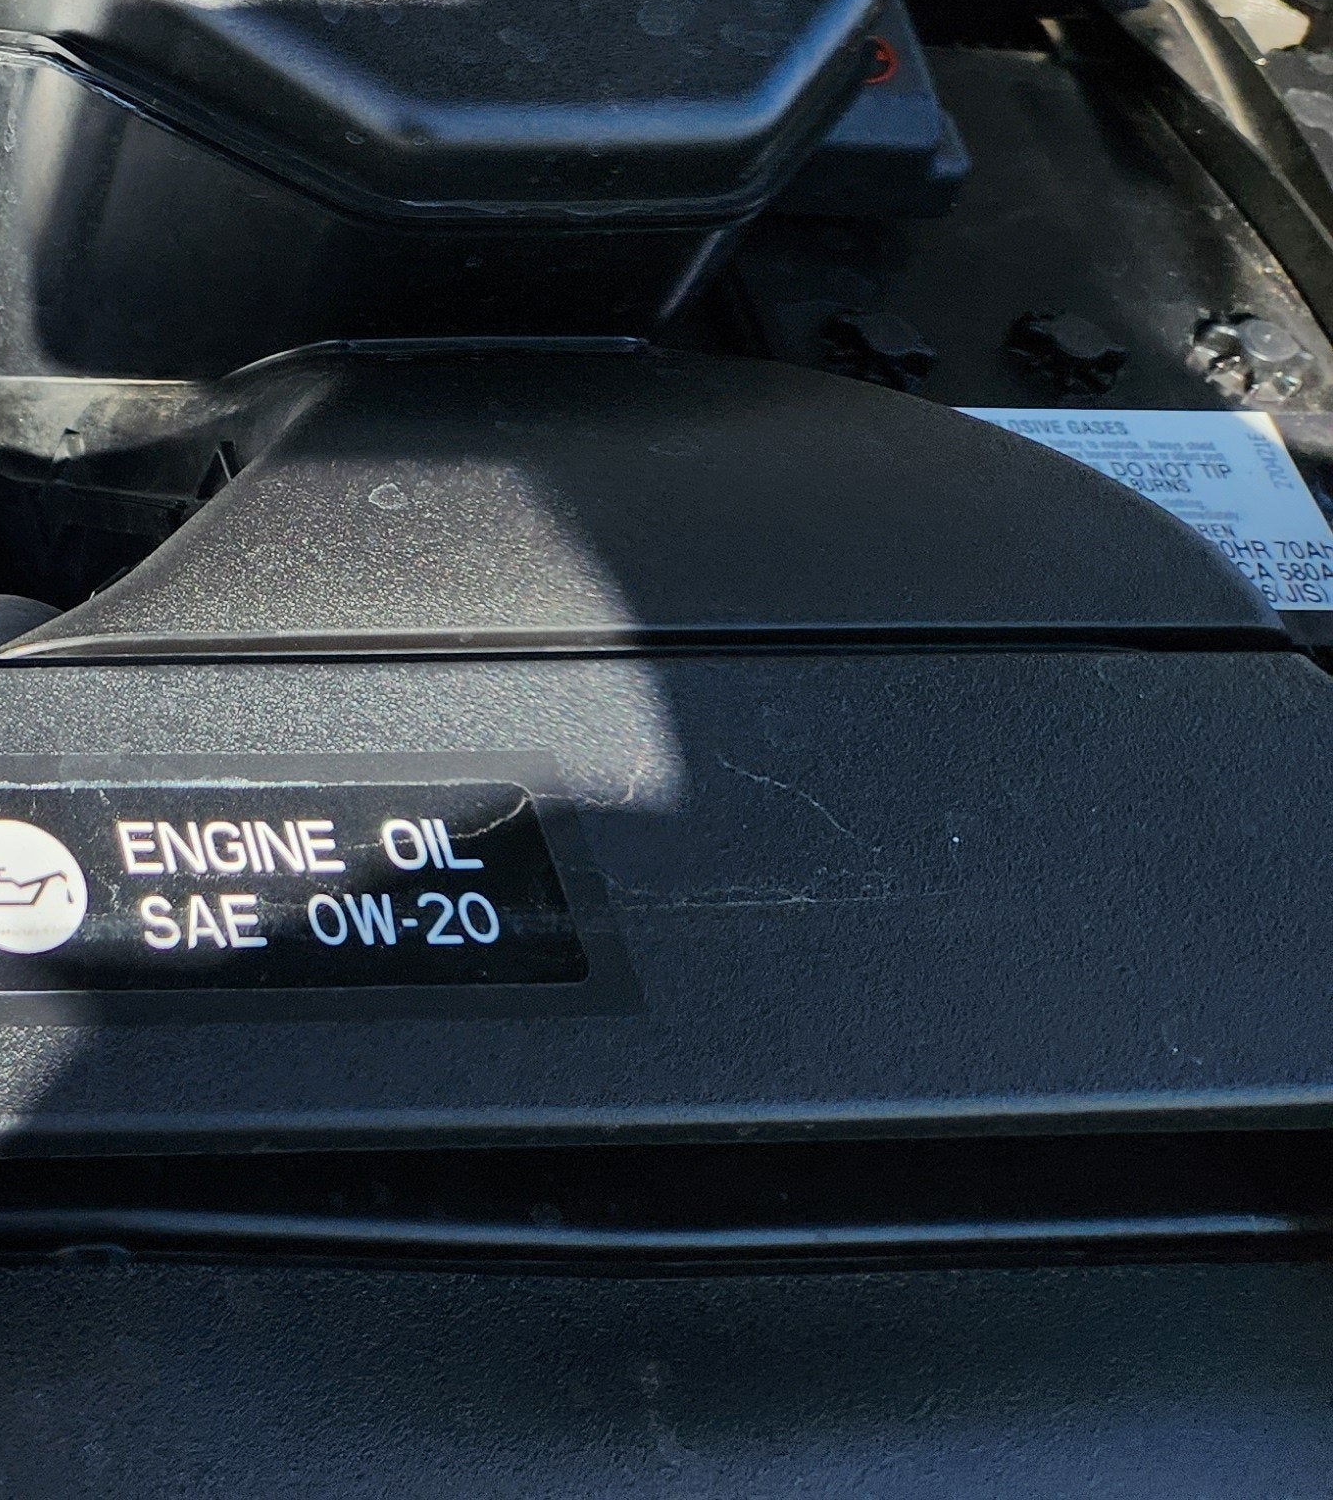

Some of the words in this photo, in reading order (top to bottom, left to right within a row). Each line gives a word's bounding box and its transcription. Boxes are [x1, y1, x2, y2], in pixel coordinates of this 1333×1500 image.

[1066, 419, 1129, 435] GASES
[1110, 461, 1144, 478] DO
[1146, 462, 1194, 479] NOT
[1196, 462, 1232, 480] TIP
[116, 819, 347, 876] ENGINE
[381, 818, 485, 872] OIL
[139, 893, 269, 950] SAE
[307, 891, 501, 946] 0W-20
